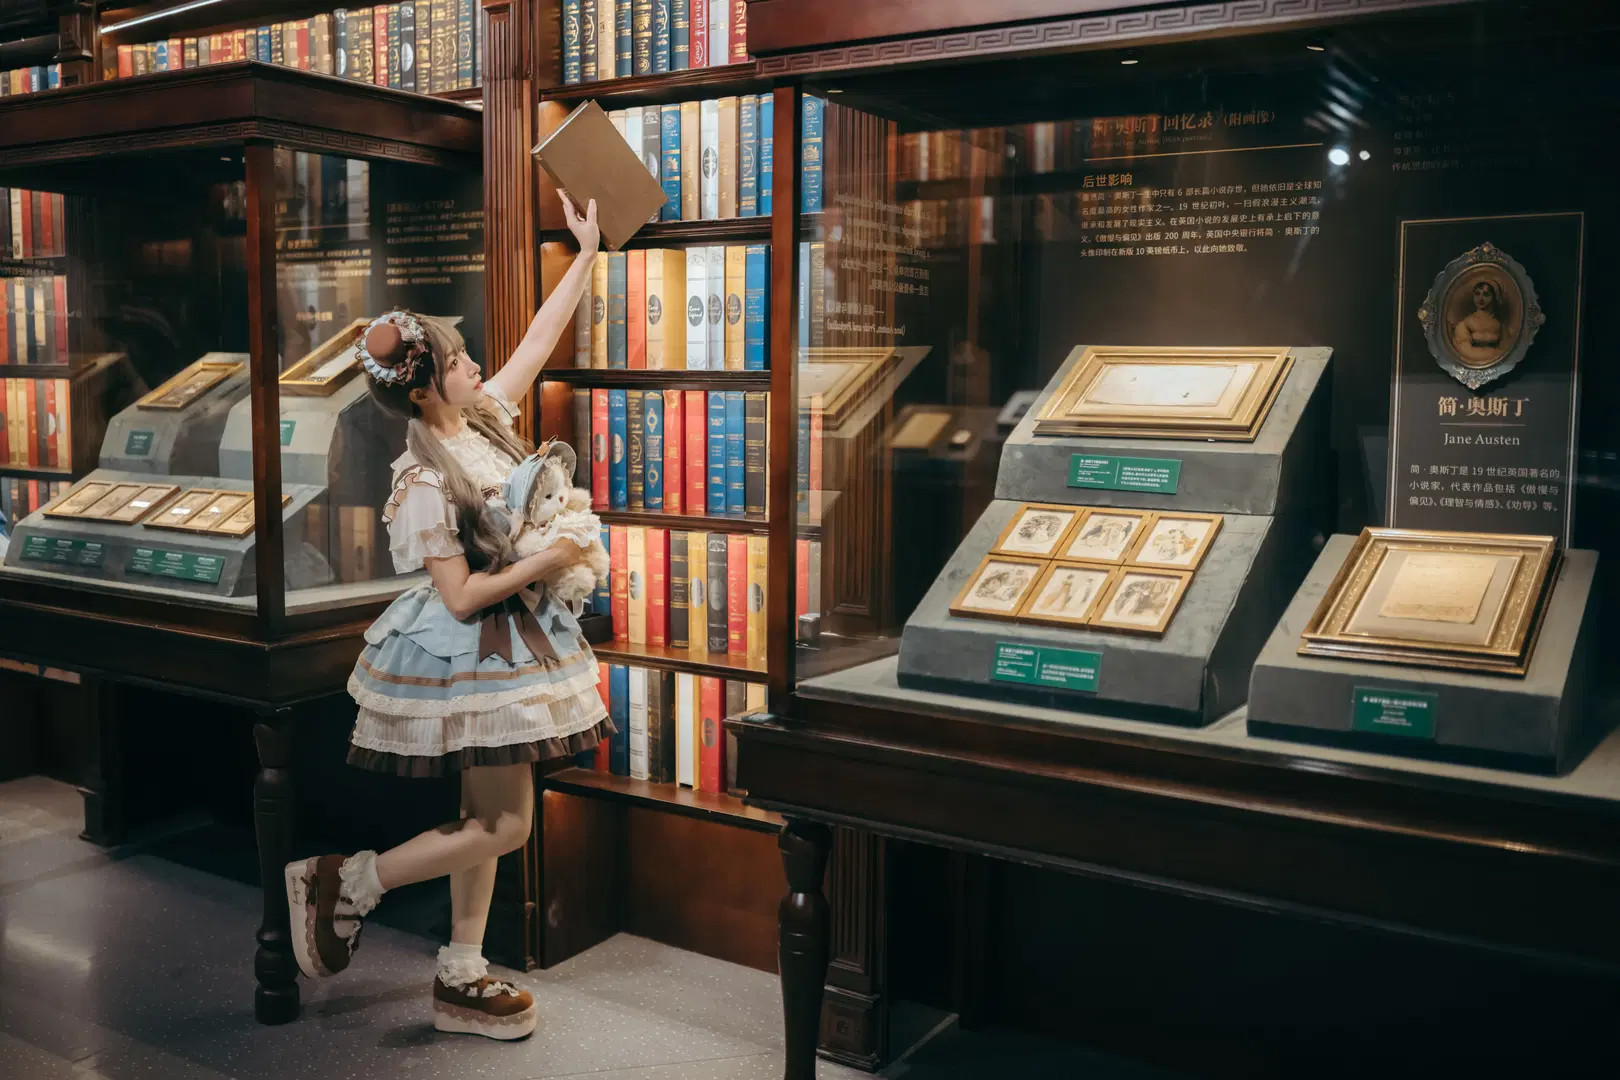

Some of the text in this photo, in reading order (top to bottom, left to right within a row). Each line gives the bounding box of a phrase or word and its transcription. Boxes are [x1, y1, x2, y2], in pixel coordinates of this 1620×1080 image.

[1082, 172, 1133, 189] 后世影响
[1437, 396, 1530, 417] 简·奥斯丁
[1443, 433, 1520, 446] Jane Austen
